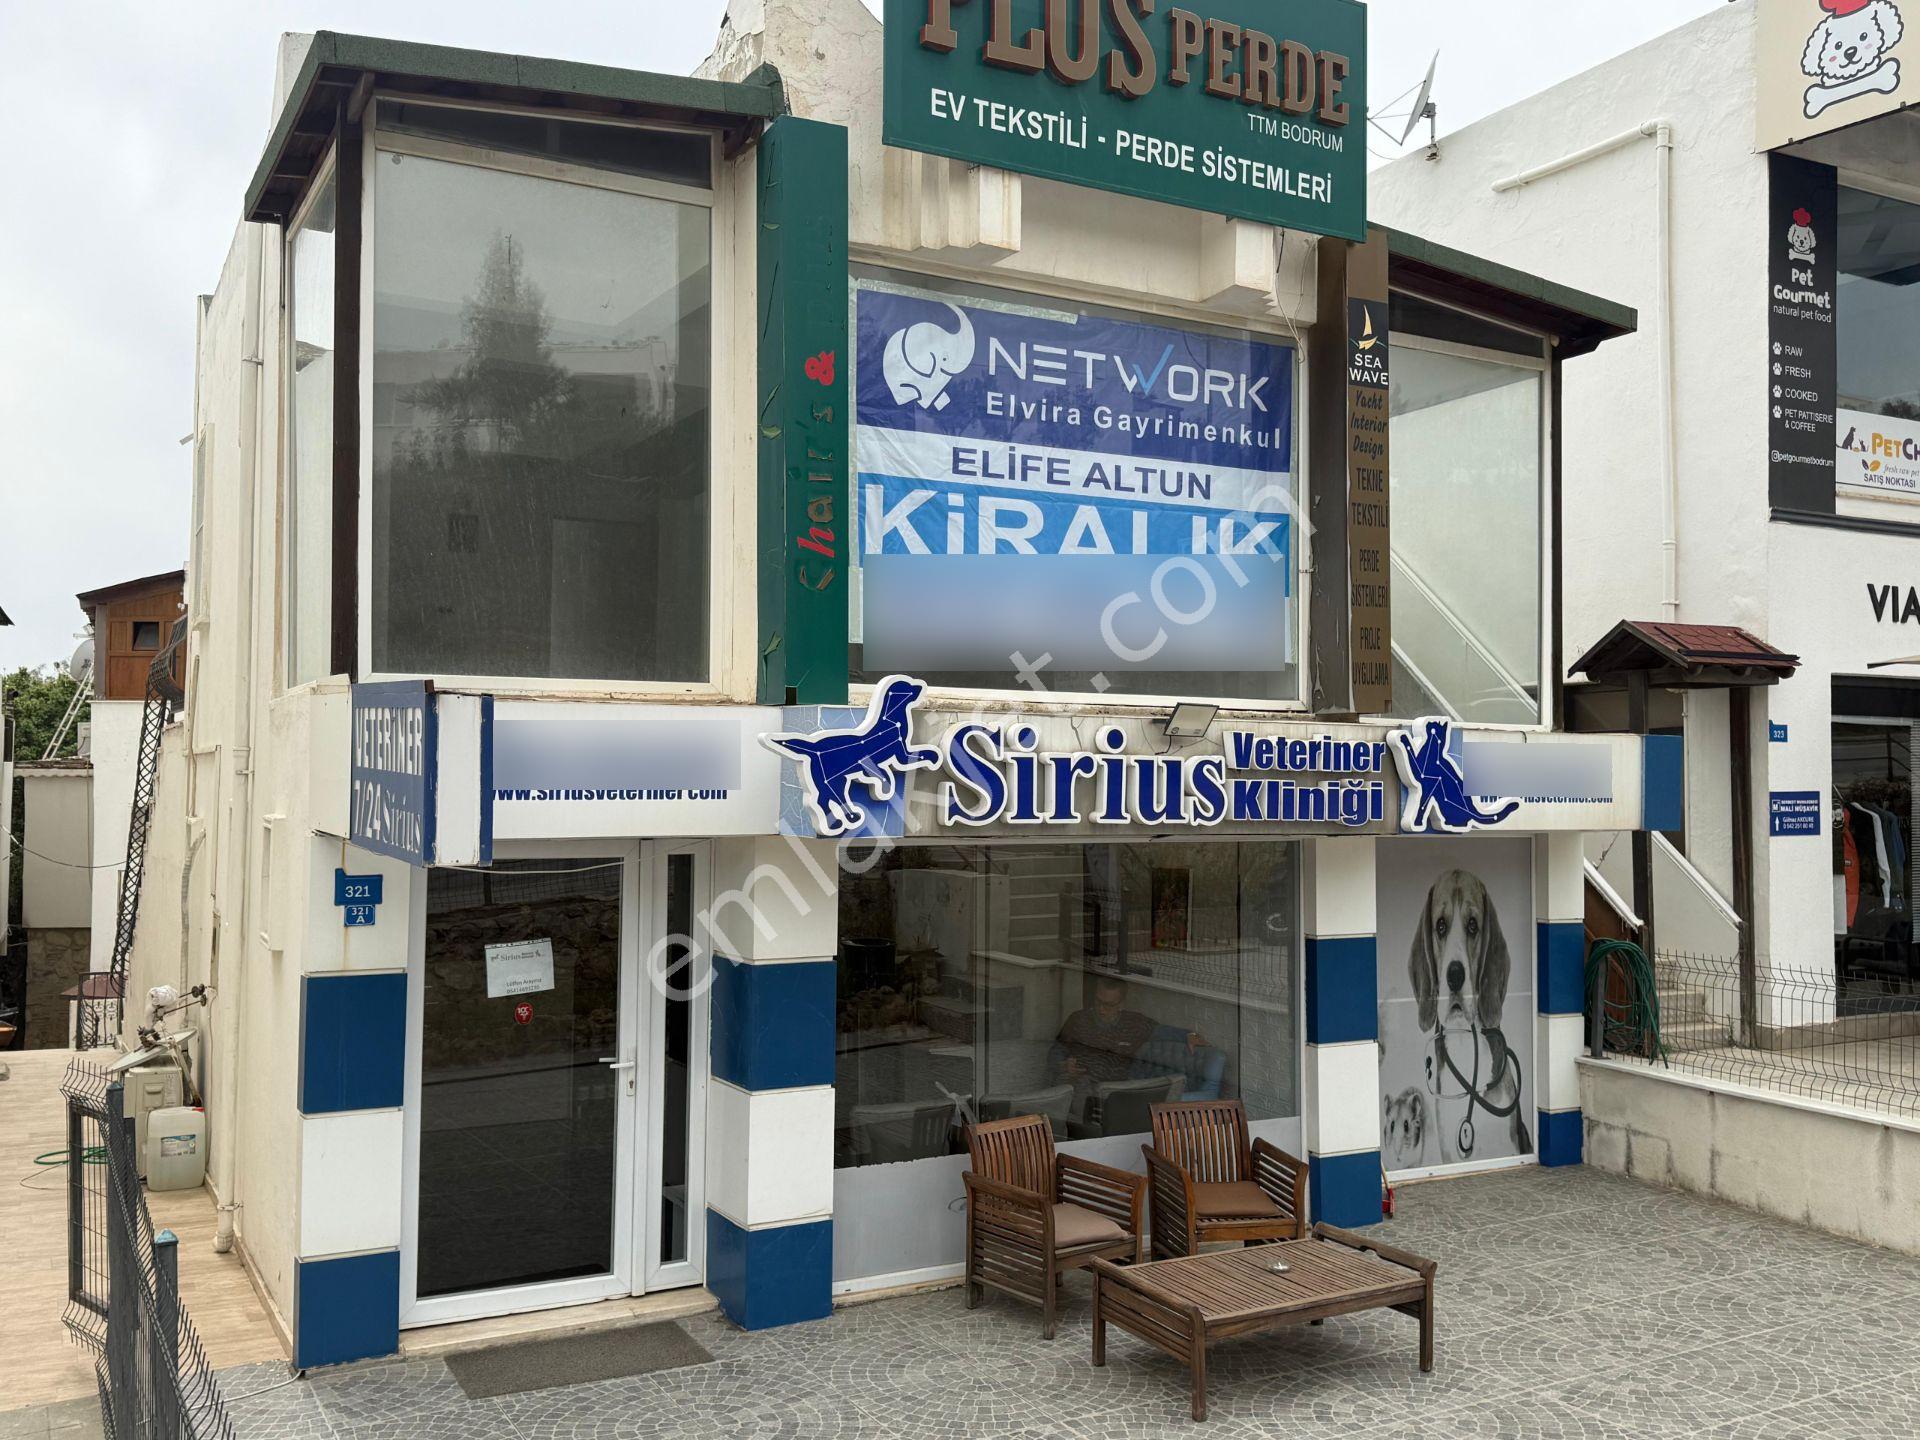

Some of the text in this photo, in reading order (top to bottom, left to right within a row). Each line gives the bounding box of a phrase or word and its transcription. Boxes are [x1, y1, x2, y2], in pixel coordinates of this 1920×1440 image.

[1168, 7, 1350, 126] PERDE
[930, 87, 967, 122] EV
[972, 98, 1089, 150] TEKSTİLİ
[1115, 129, 1195, 173] PERDE
[1201, 146, 1333, 203] SİSTEMLERİ
[1247, 112, 1343, 154] TTM BODRUM
[1791, 267, 1814, 287] Pet
[1773, 284, 1831, 309] Gourmet
[1773, 305, 1832, 323] natural pet food
[1354, 353, 1383, 369] SEA
[1784, 345, 1803, 357] RAW
[988, 336, 1270, 412] NETWORK
[1349, 367, 1389, 385] WAVE
[1784, 365, 1812, 379] FRESH
[1355, 390, 1383, 411] Yacht
[1784, 388, 1818, 402] COOKED
[986, 391, 1281, 450] Elvira Gayrimenkul
[1350, 412, 1387, 434] Interior
[1784, 408, 1798, 419] PET
[1790, 420, 1816, 432] COFFEE
[1353, 434, 1384, 460] Design
[952, 446, 1211, 500] ELİFE ALTUN
[1356, 467, 1383, 493] TEKNE
[1864, 473, 1916, 488] SATIŞ NOKTASI
[1352, 499, 1388, 528] TEKSTİLİ
[1359, 549, 1380, 573] PERDE
[1352, 575, 1388, 608] SİSTEMLERİ
[1360, 627, 1381, 651] PROJE
[1352, 662, 1389, 686] UYGULAMA
[1773, 730, 1785, 739] 323
[1230, 730, 1386, 774] Veteriner
[939, 722, 1228, 827] Sirius
[1228, 778, 1386, 826] Kliniği
[354, 777, 421, 854] 7/24 Sirius
[345, 885, 371, 898] 321
[351, 907, 369, 916] 321
[356, 915, 365, 924] A
